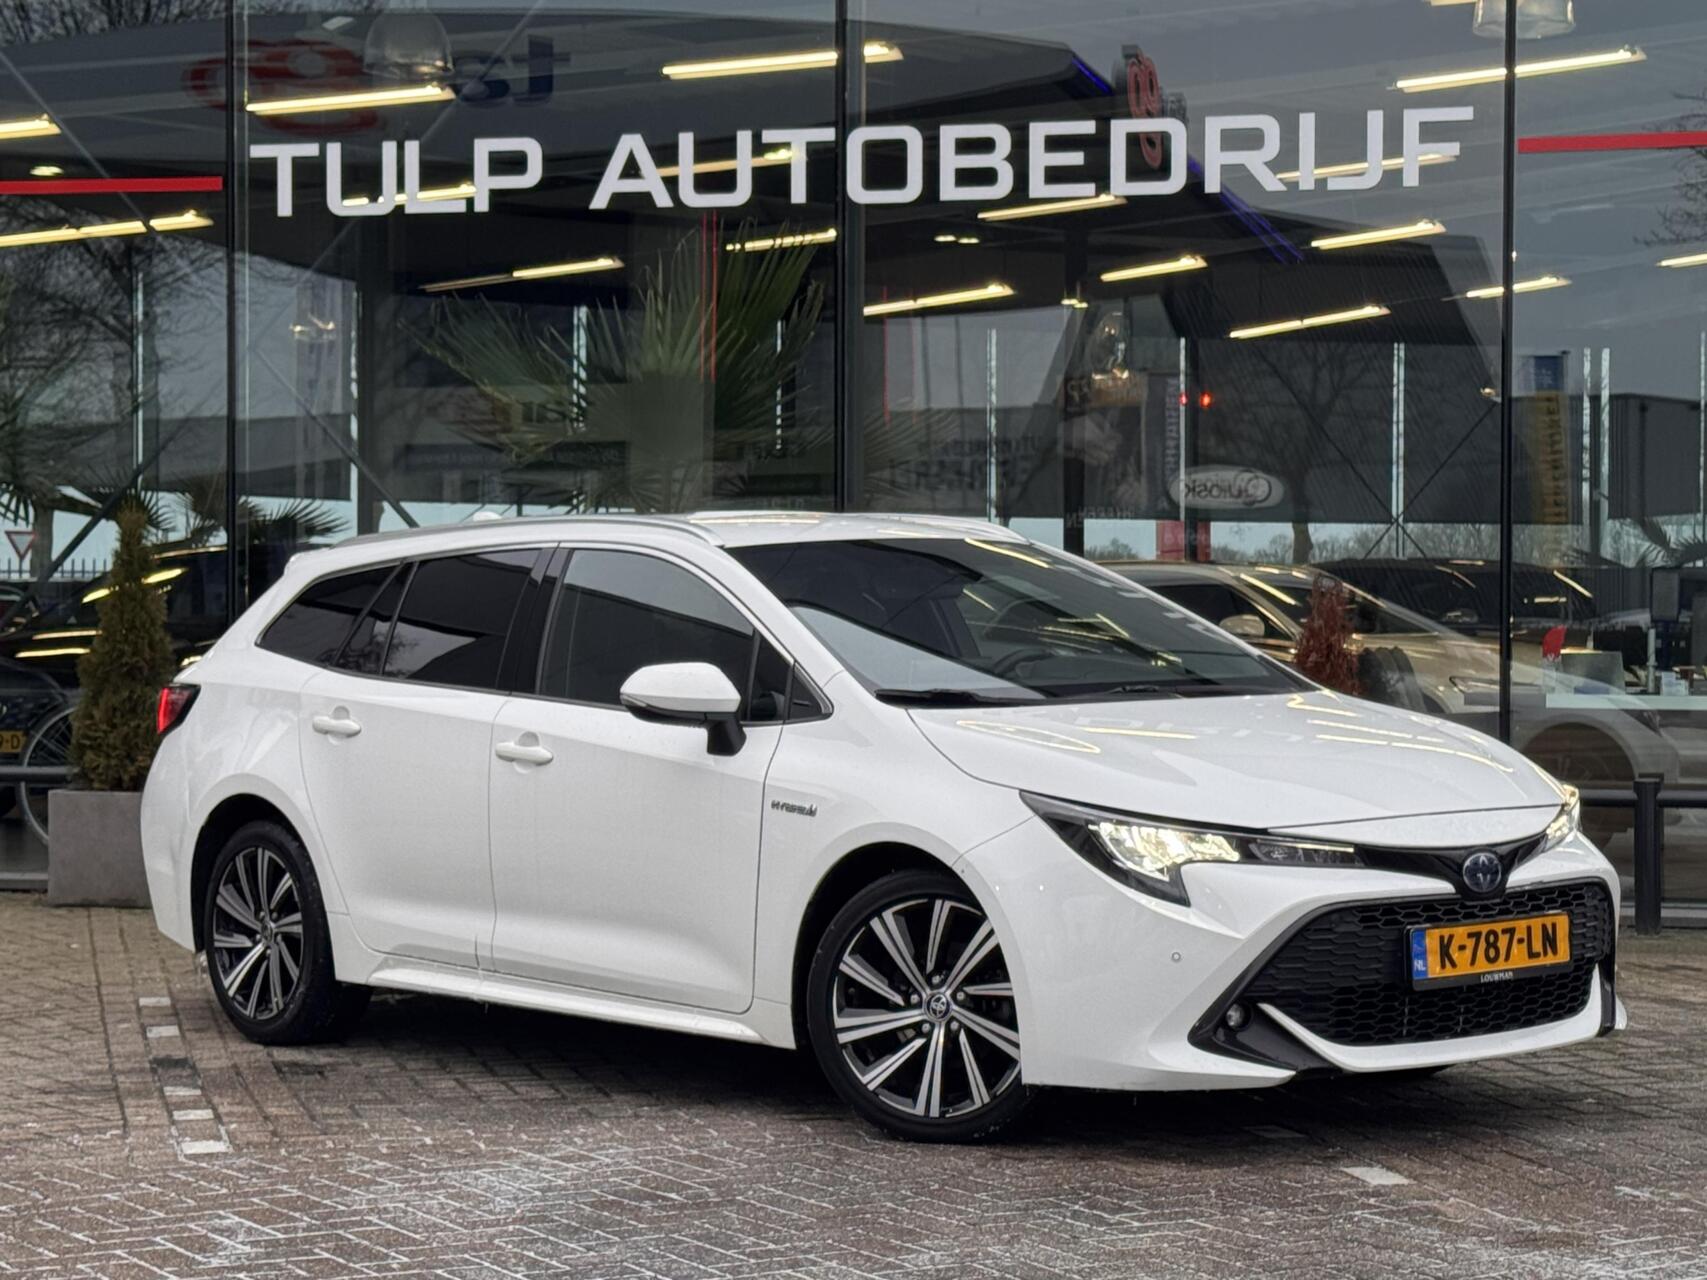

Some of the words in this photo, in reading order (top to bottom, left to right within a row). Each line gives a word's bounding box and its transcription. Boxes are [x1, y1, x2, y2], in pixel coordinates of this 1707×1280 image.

[249, 136, 544, 218] TULP
[588, 105, 1475, 210] AUTOBEDRIJF
[1414, 958, 1427, 971] NL
[1438, 921, 1559, 971] K-787-LN
